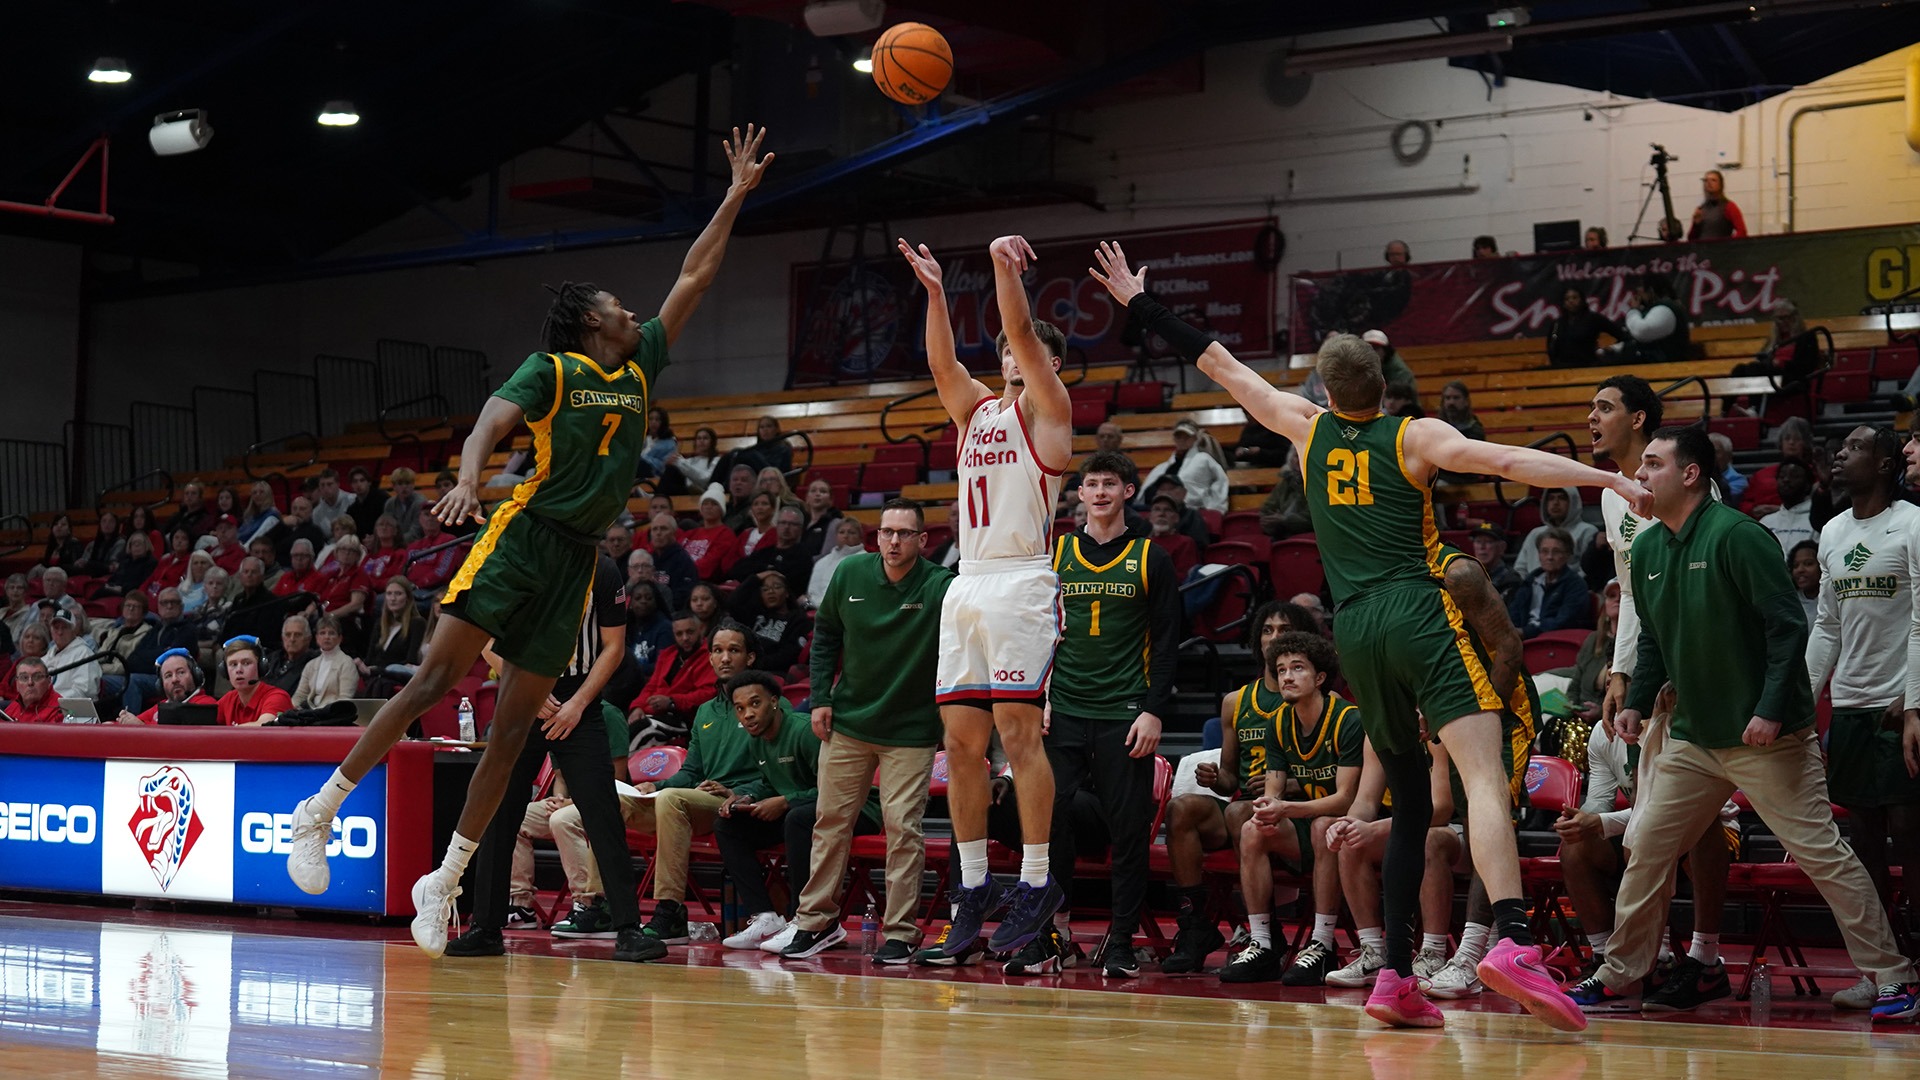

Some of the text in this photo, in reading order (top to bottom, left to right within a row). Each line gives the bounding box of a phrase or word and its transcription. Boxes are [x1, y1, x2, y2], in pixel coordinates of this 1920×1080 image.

[1555, 252, 1711, 282] Welcome to the
[1688, 265, 1782, 316] Pit
[570, 390, 643, 414] SAINT LEO
[597, 412, 623, 457] 7
[1325, 447, 1375, 506] 21
[1061, 582, 1136, 598] SAINT LEO
[1832, 575, 1897, 593] AINT LEO
[1088, 600, 1101, 637] 1
[1238, 727, 1267, 742] SAIN
[0, 802, 97, 845] EICO
